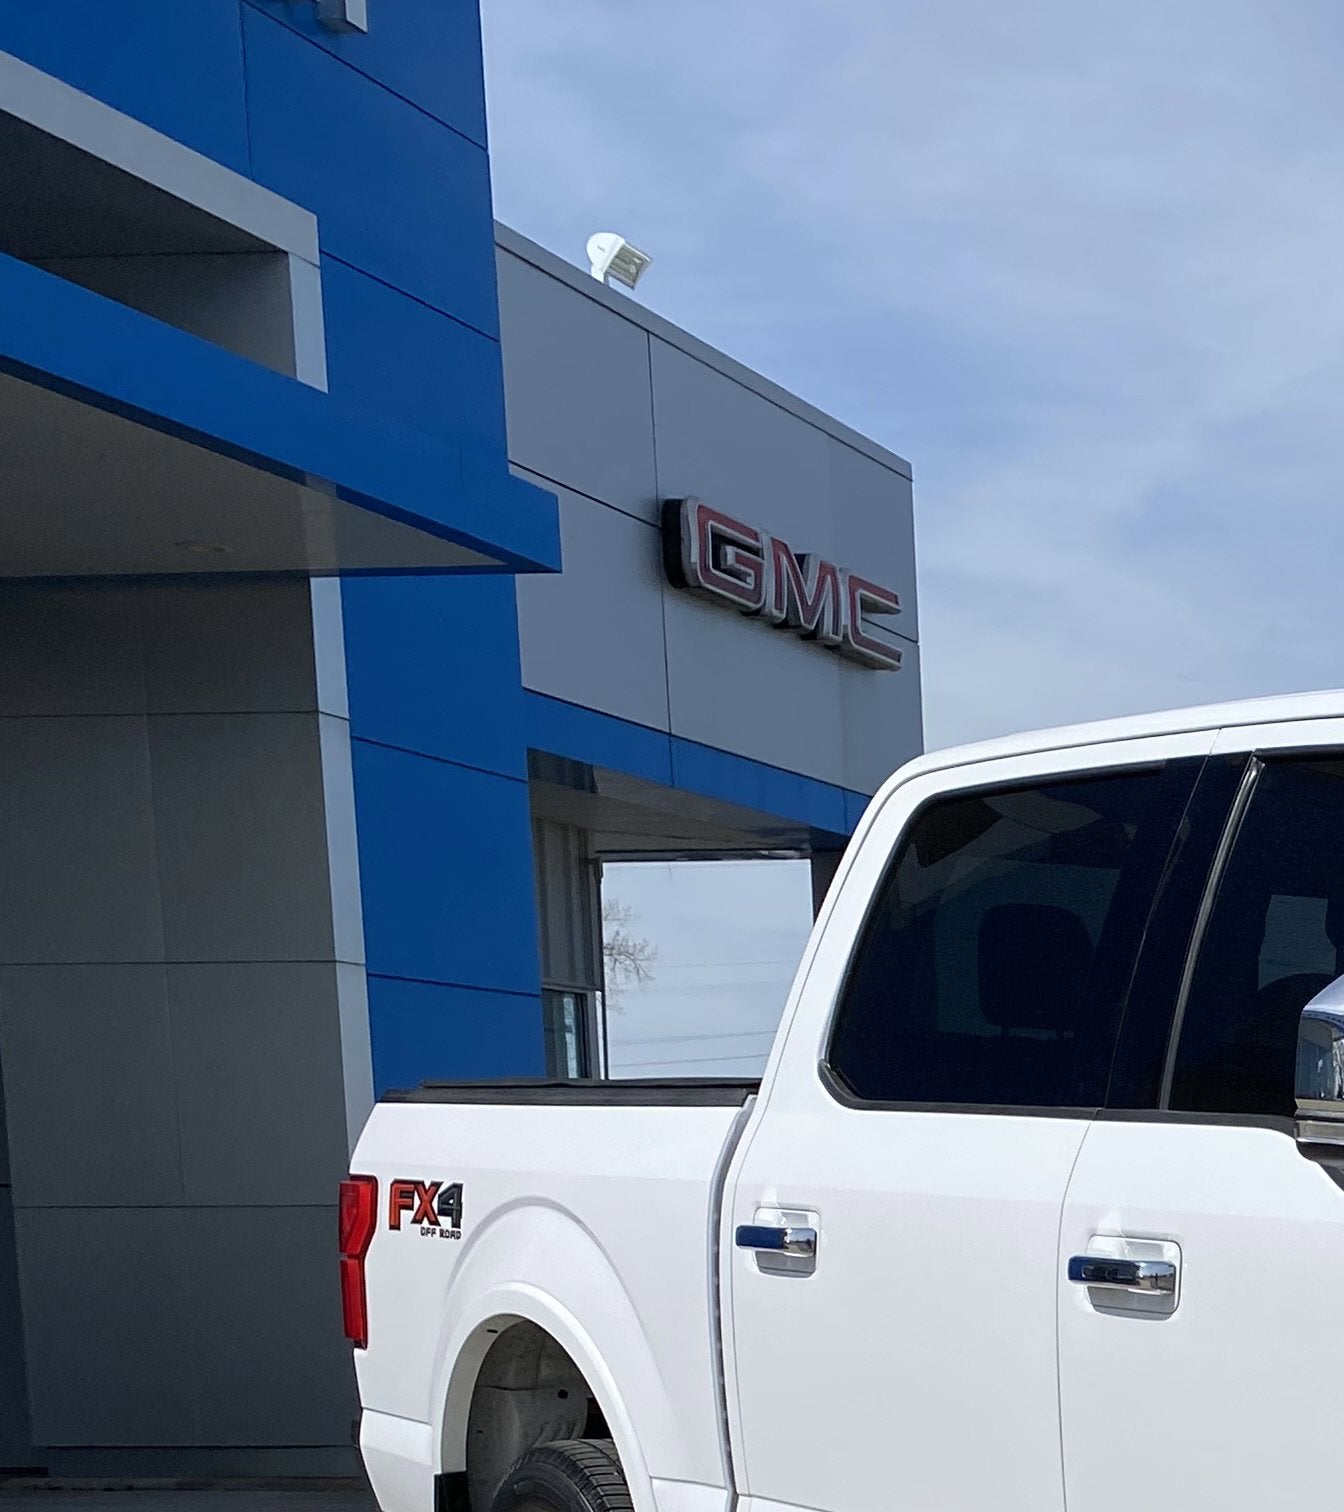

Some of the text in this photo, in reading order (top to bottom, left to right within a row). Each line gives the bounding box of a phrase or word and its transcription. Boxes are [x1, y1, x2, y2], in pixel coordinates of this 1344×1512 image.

[680, 497, 903, 670] GMC
[389, 1178, 464, 1231] FX4
[420, 1226, 462, 1240] OFF ROAD
